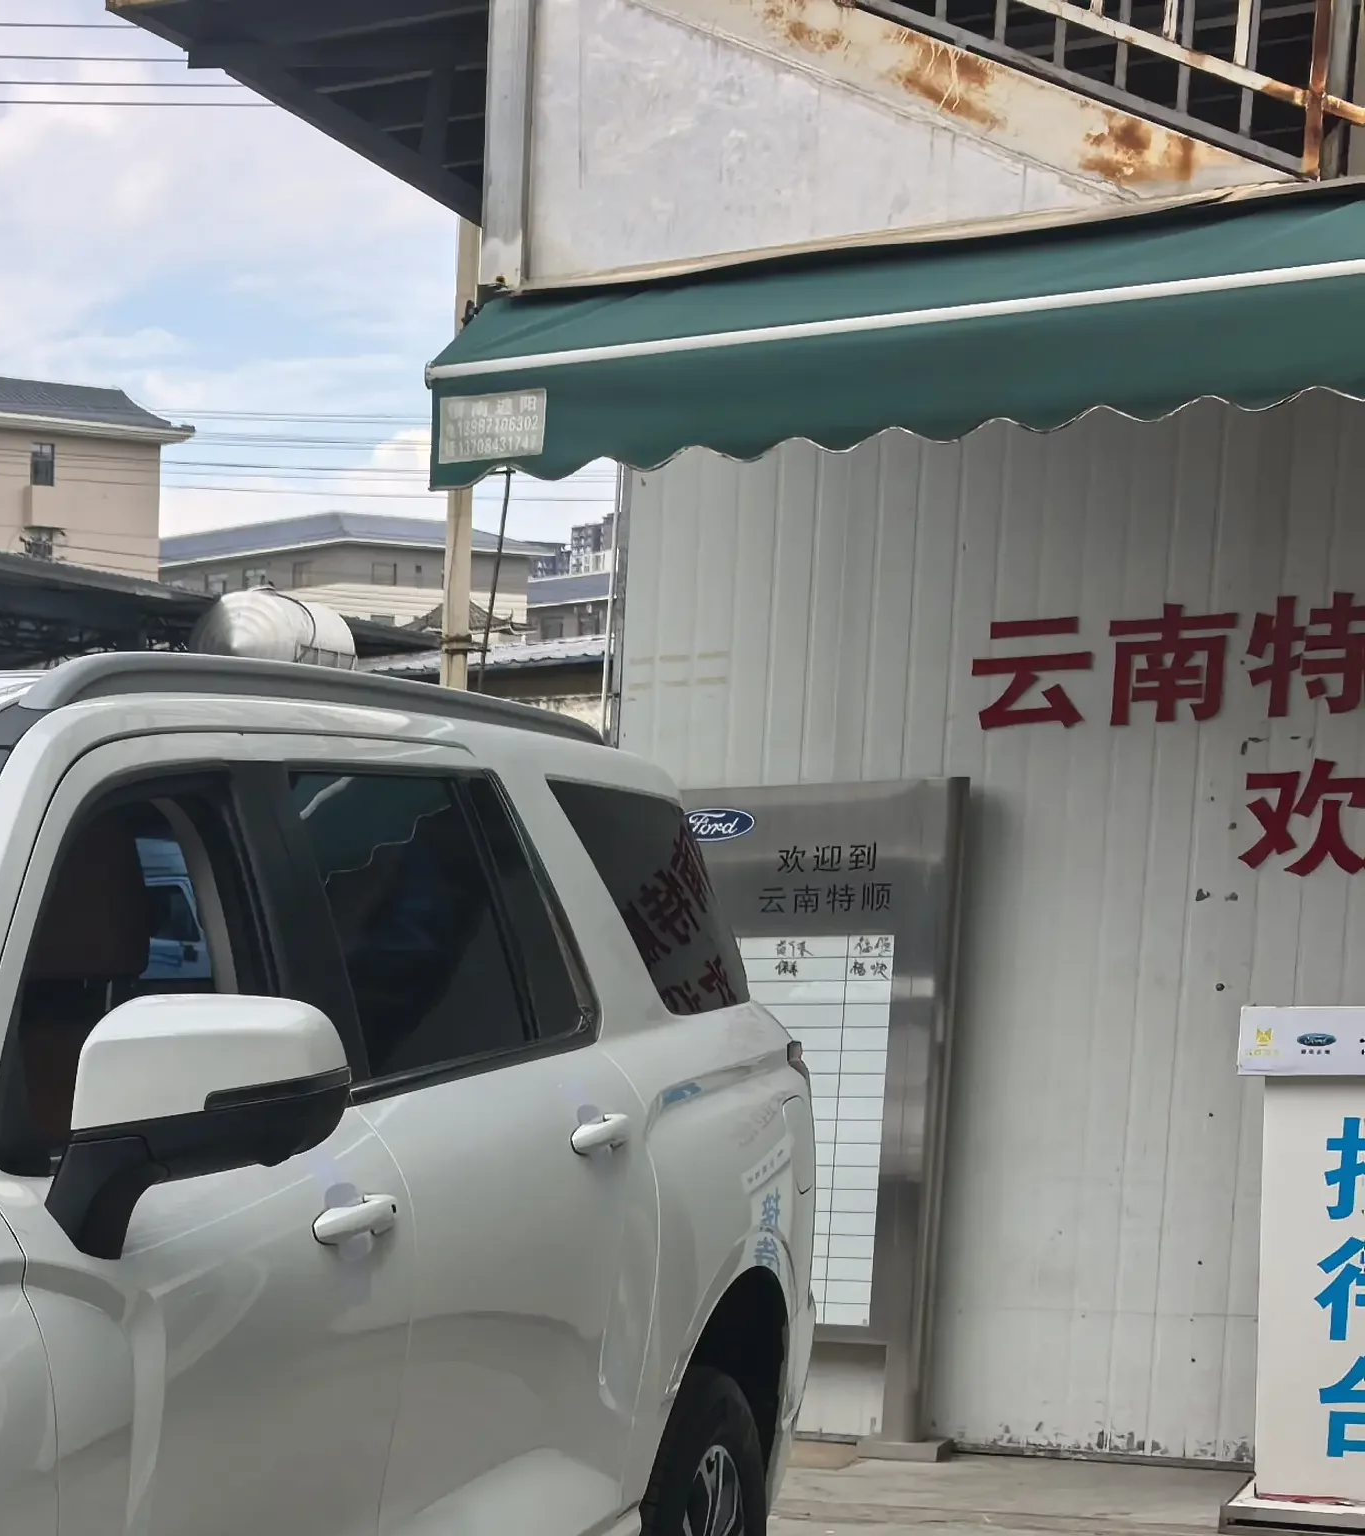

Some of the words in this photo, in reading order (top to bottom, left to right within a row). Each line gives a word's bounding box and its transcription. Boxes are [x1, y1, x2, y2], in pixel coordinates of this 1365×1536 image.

[972, 591, 1365, 730] 云南特
[688, 812, 740, 835] Ford
[1237, 758, 1365, 876] 欢
[777, 841, 877, 873] 欢迎到
[759, 882, 892, 914] 云南特顺
